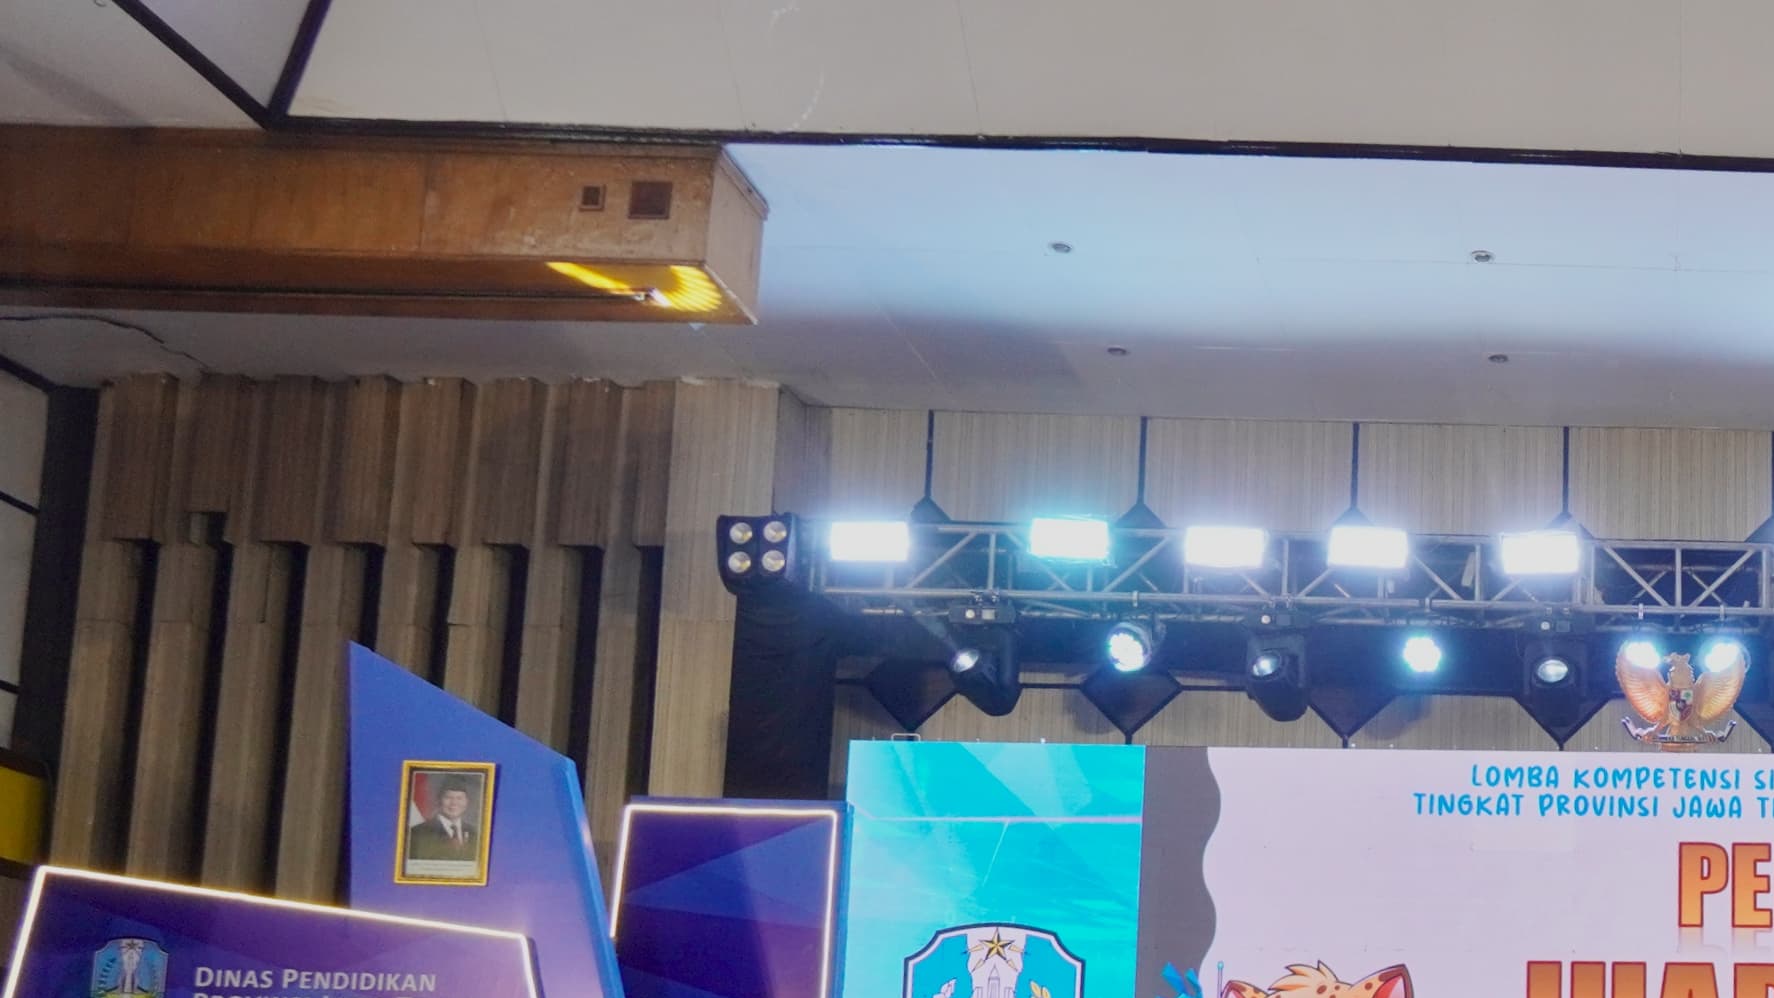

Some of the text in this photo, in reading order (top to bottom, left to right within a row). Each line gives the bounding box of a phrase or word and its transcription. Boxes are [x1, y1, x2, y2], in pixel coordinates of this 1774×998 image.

[1471, 764, 1559, 789] LOMBA
[1573, 767, 1741, 791] KOMPETENSI
[1413, 792, 1525, 817] TINGKAT
[1538, 794, 1658, 818] PROVINSI
[1672, 796, 1743, 819] JAWA
[194, 967, 437, 992] DINAS PENDIDIKAN
